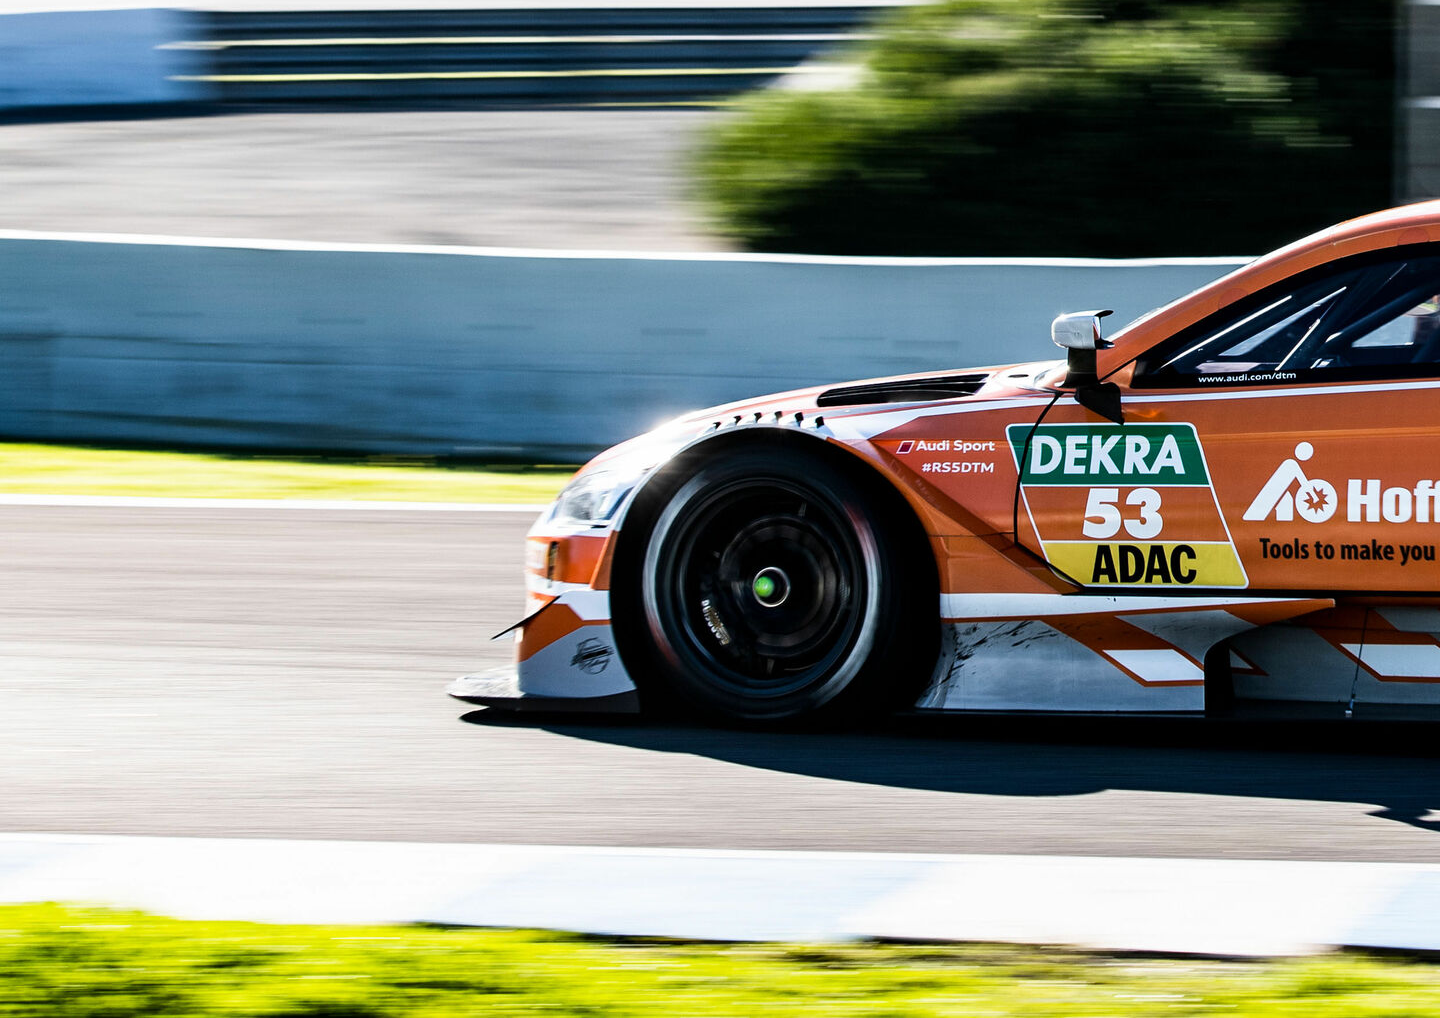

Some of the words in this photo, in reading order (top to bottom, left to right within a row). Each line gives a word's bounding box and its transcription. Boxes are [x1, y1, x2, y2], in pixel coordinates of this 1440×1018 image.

[1198, 371, 1297, 383] www.audi.com/dtm
[915, 440, 951, 453] Audi
[953, 440, 996, 456] Sport
[1029, 434, 1186, 475] DEKRA
[921, 462, 995, 474] #RS5DTM
[1082, 488, 1164, 540] 53
[1091, 544, 1197, 585] ADAC
[1259, 537, 1309, 560] Tools
[1314, 541, 1335, 560] to
[1340, 539, 1395, 561] make
[1399, 543, 1436, 567] you
